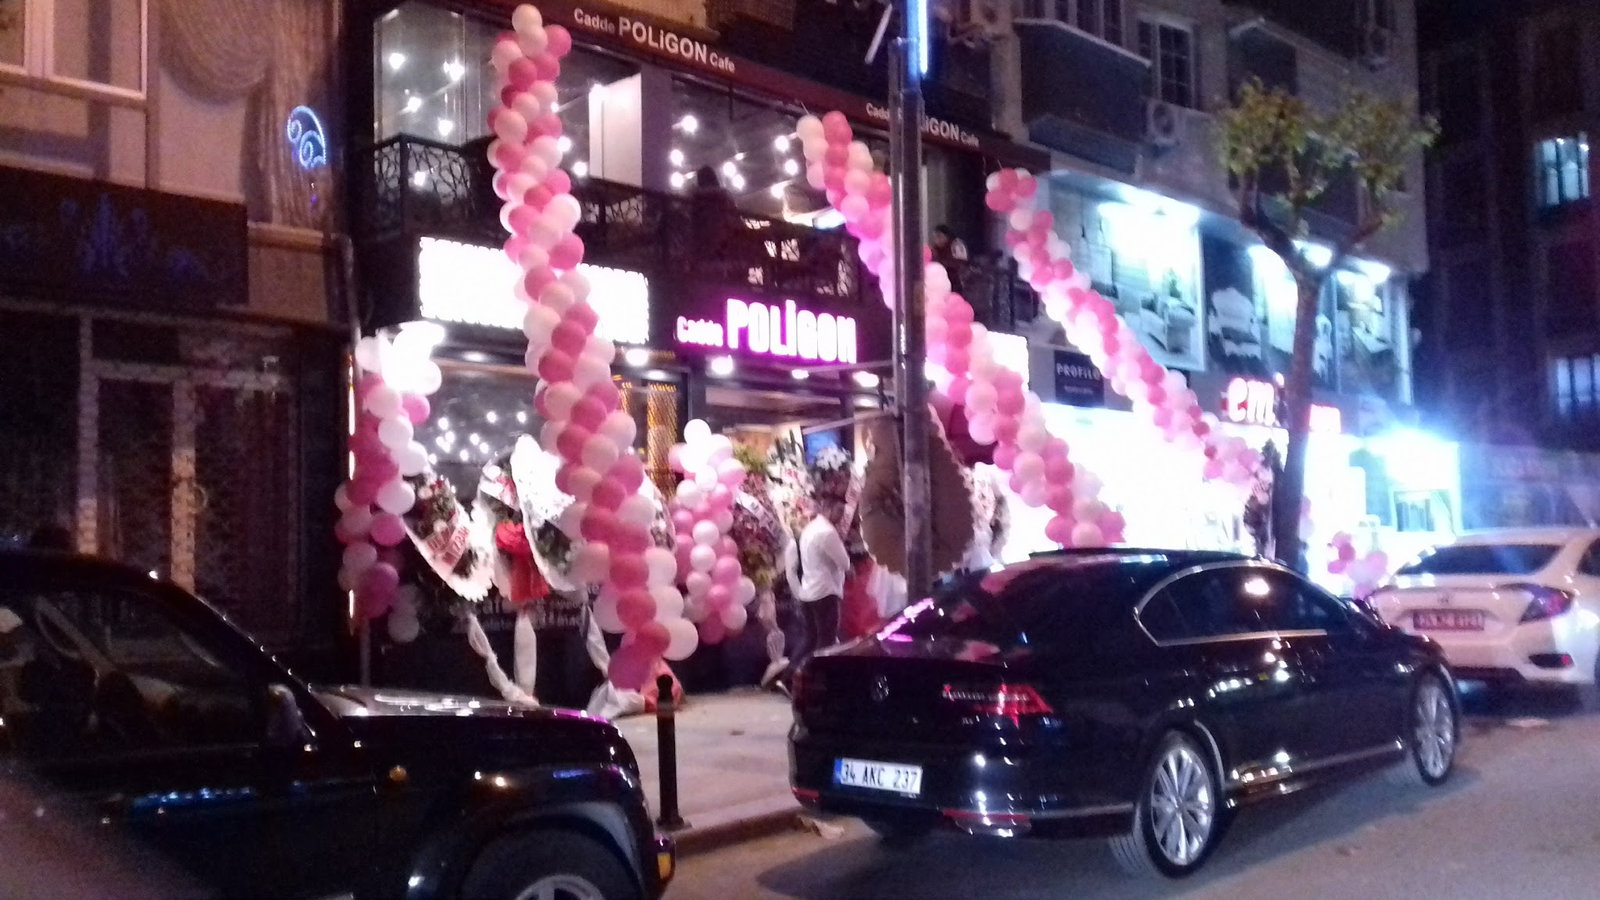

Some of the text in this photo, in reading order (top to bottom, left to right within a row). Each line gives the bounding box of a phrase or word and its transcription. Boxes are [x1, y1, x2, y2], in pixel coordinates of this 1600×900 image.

[574, 8, 615, 34] Cadde
[709, 52, 735, 74] Cafe
[841, 762, 918, 791] 34 AKC 237
